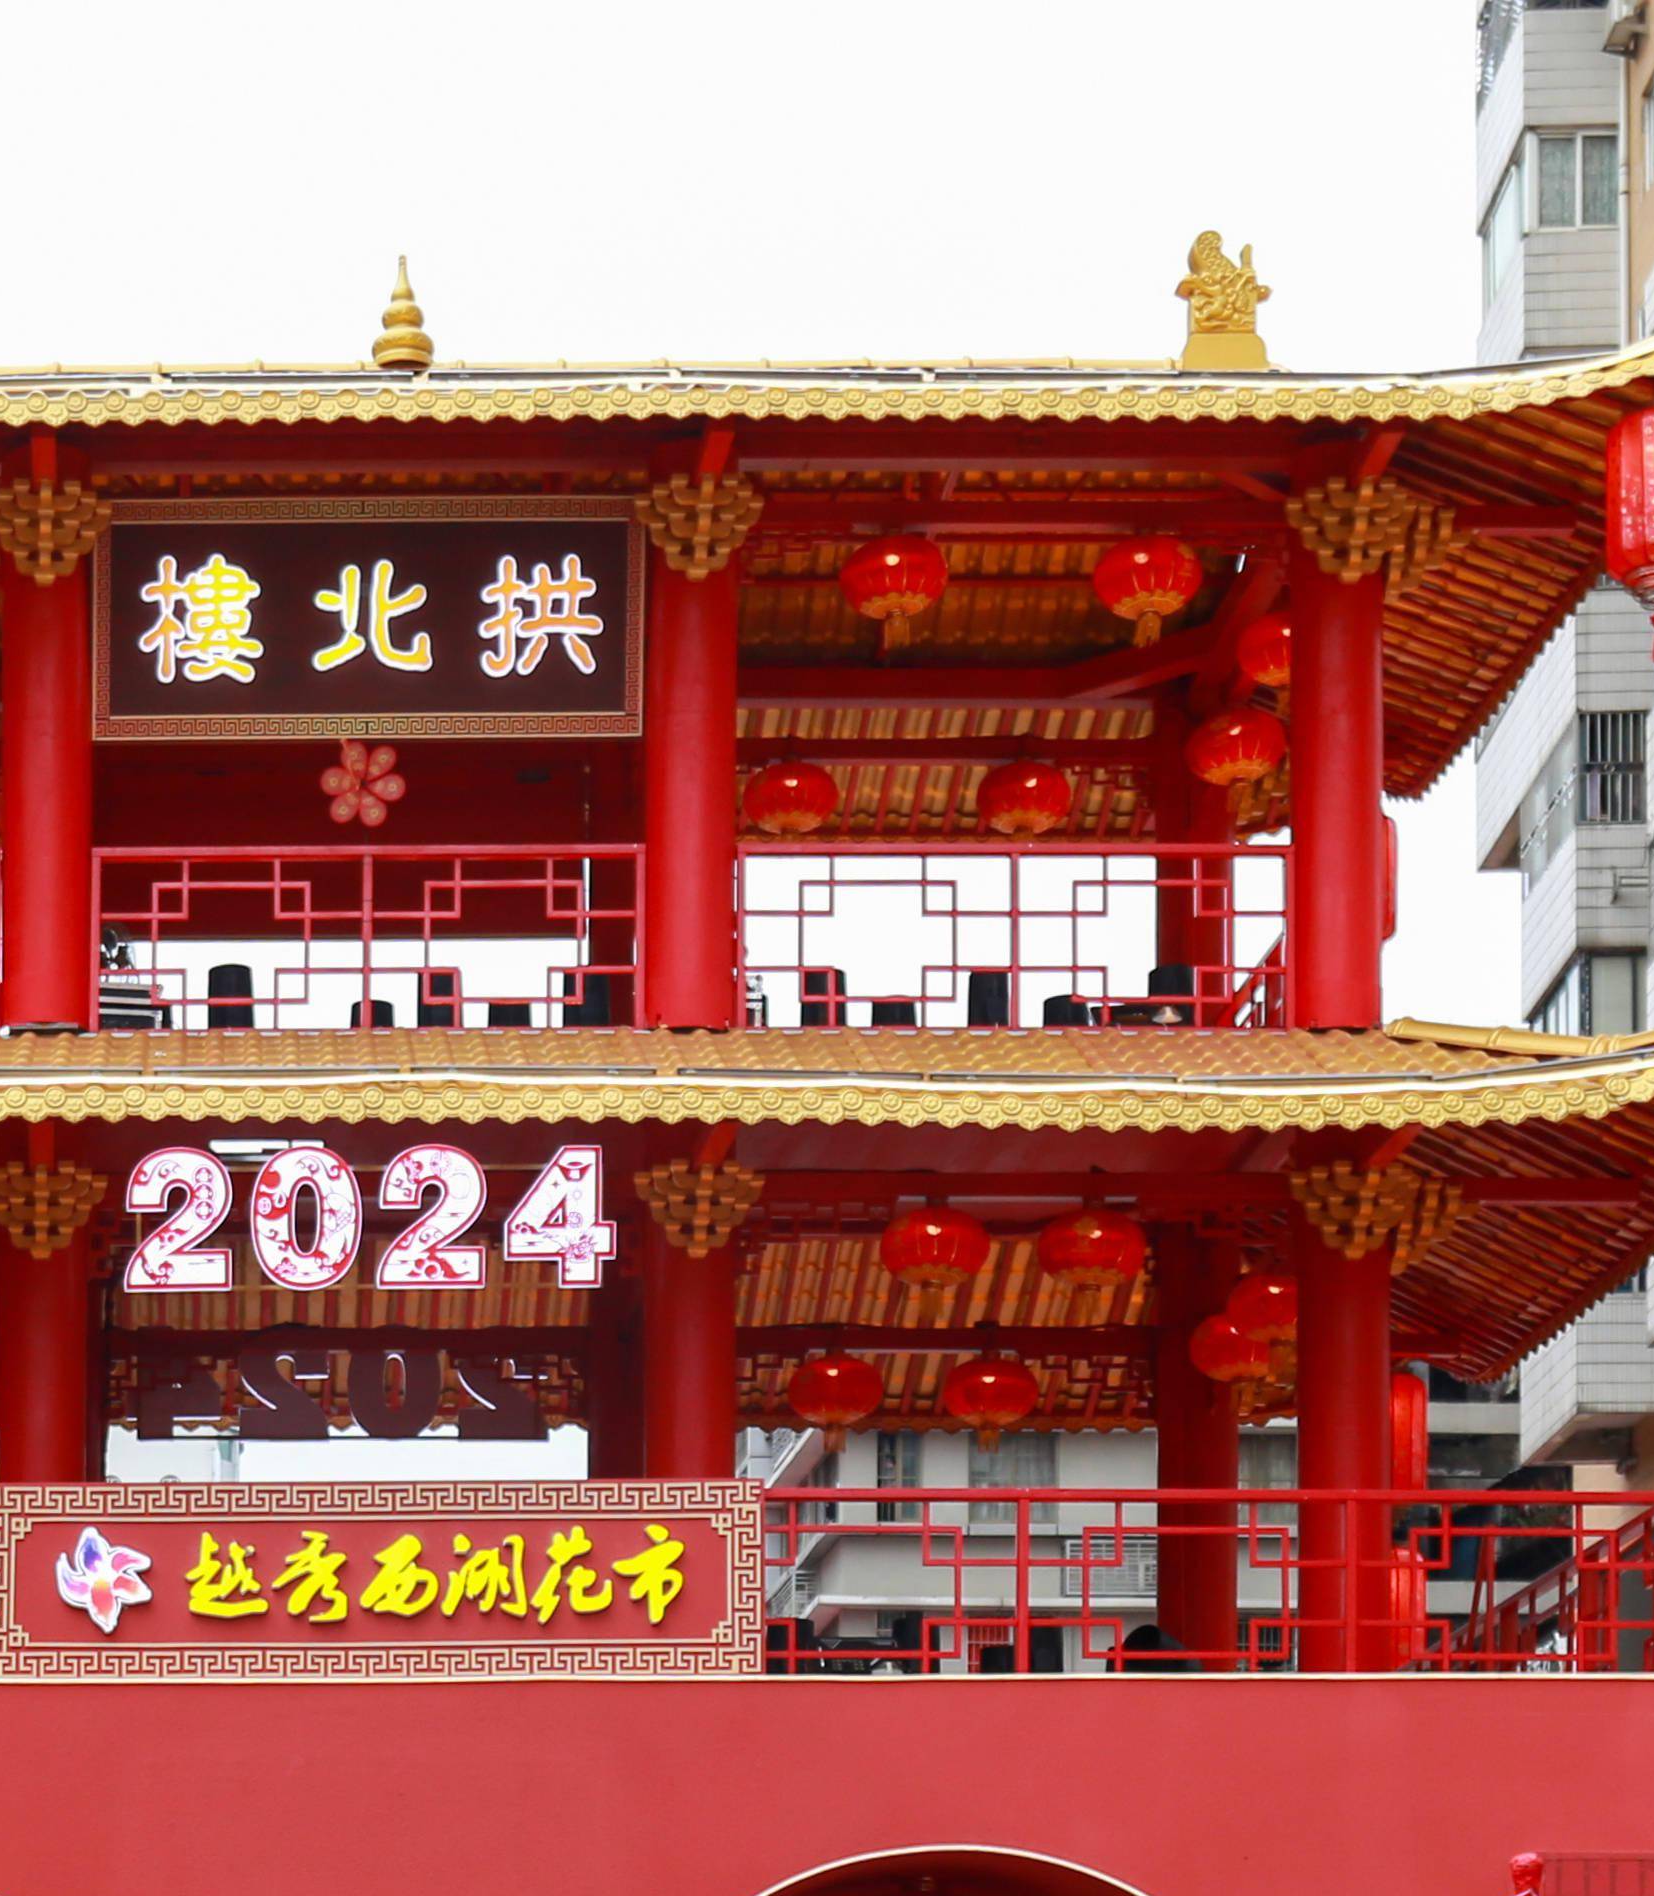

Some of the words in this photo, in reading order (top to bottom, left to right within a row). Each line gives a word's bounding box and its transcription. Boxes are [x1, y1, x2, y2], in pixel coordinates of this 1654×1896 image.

[123, 1143, 618, 1292] 2024
[184, 1523, 686, 1625] 越秀西湖花市
